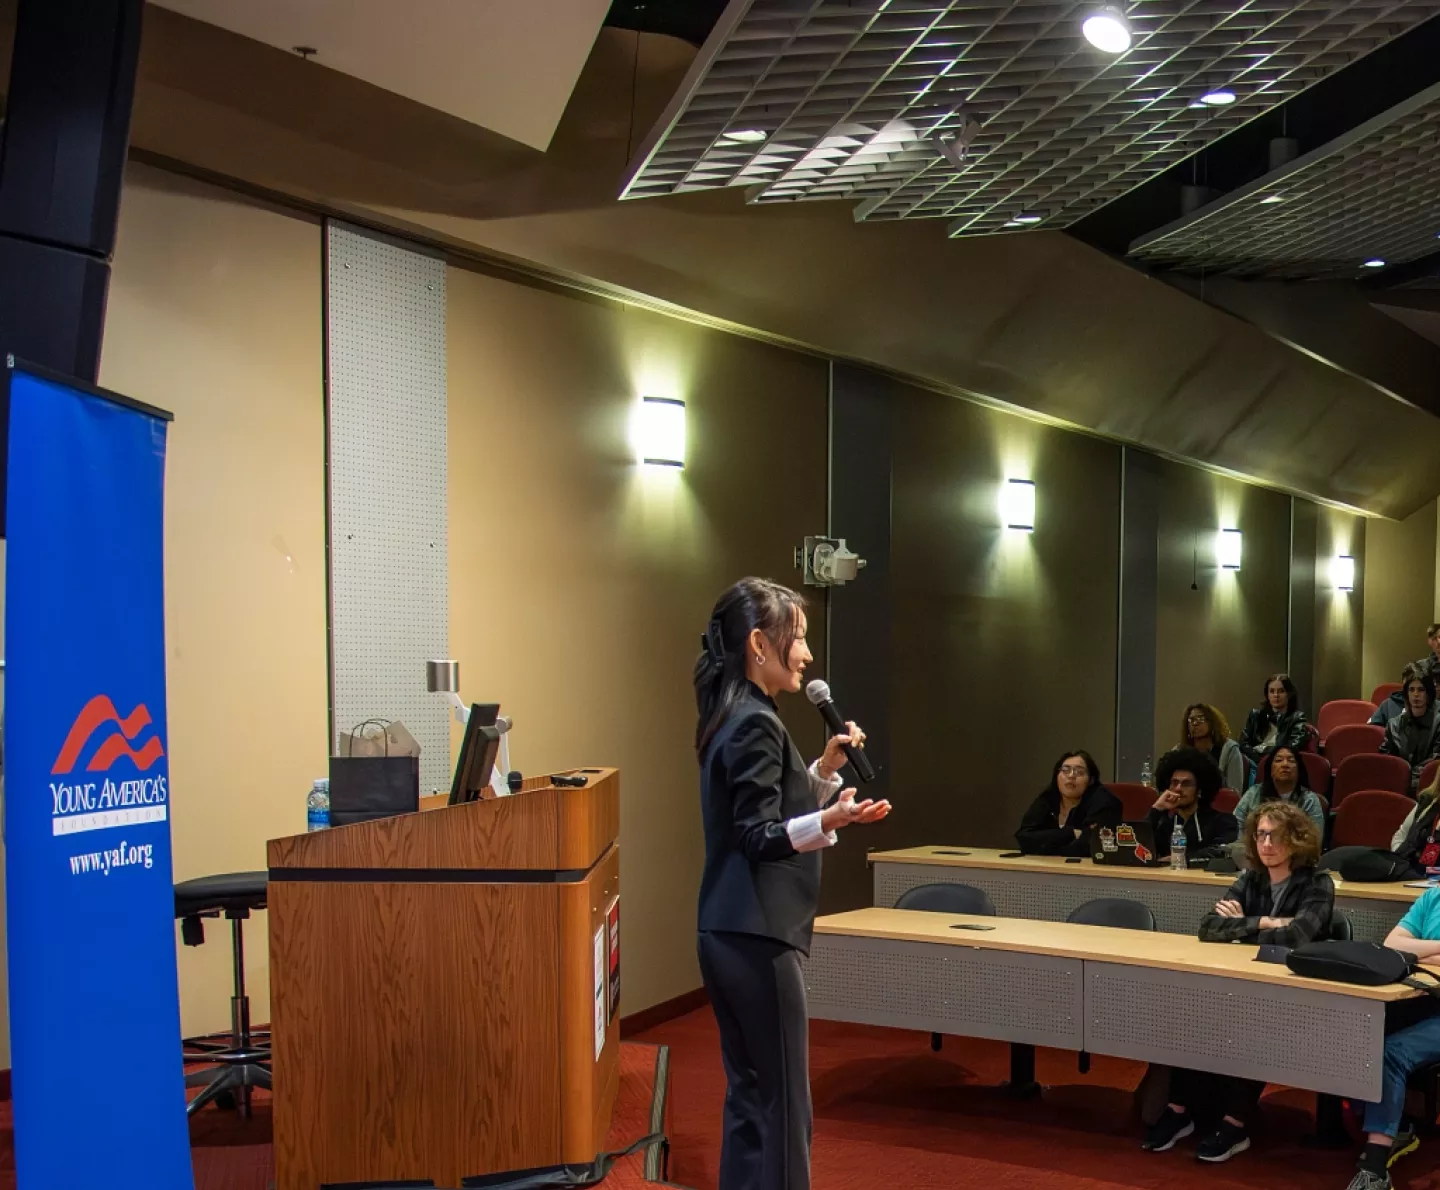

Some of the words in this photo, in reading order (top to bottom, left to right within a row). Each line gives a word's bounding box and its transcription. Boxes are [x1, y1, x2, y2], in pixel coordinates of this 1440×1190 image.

[49, 782, 96, 815] YOUNG
[98, 774, 167, 809] AMERICA'S
[60, 807, 162, 833] FOUNDATION
[69, 840, 153, 876] www.yaf.org
